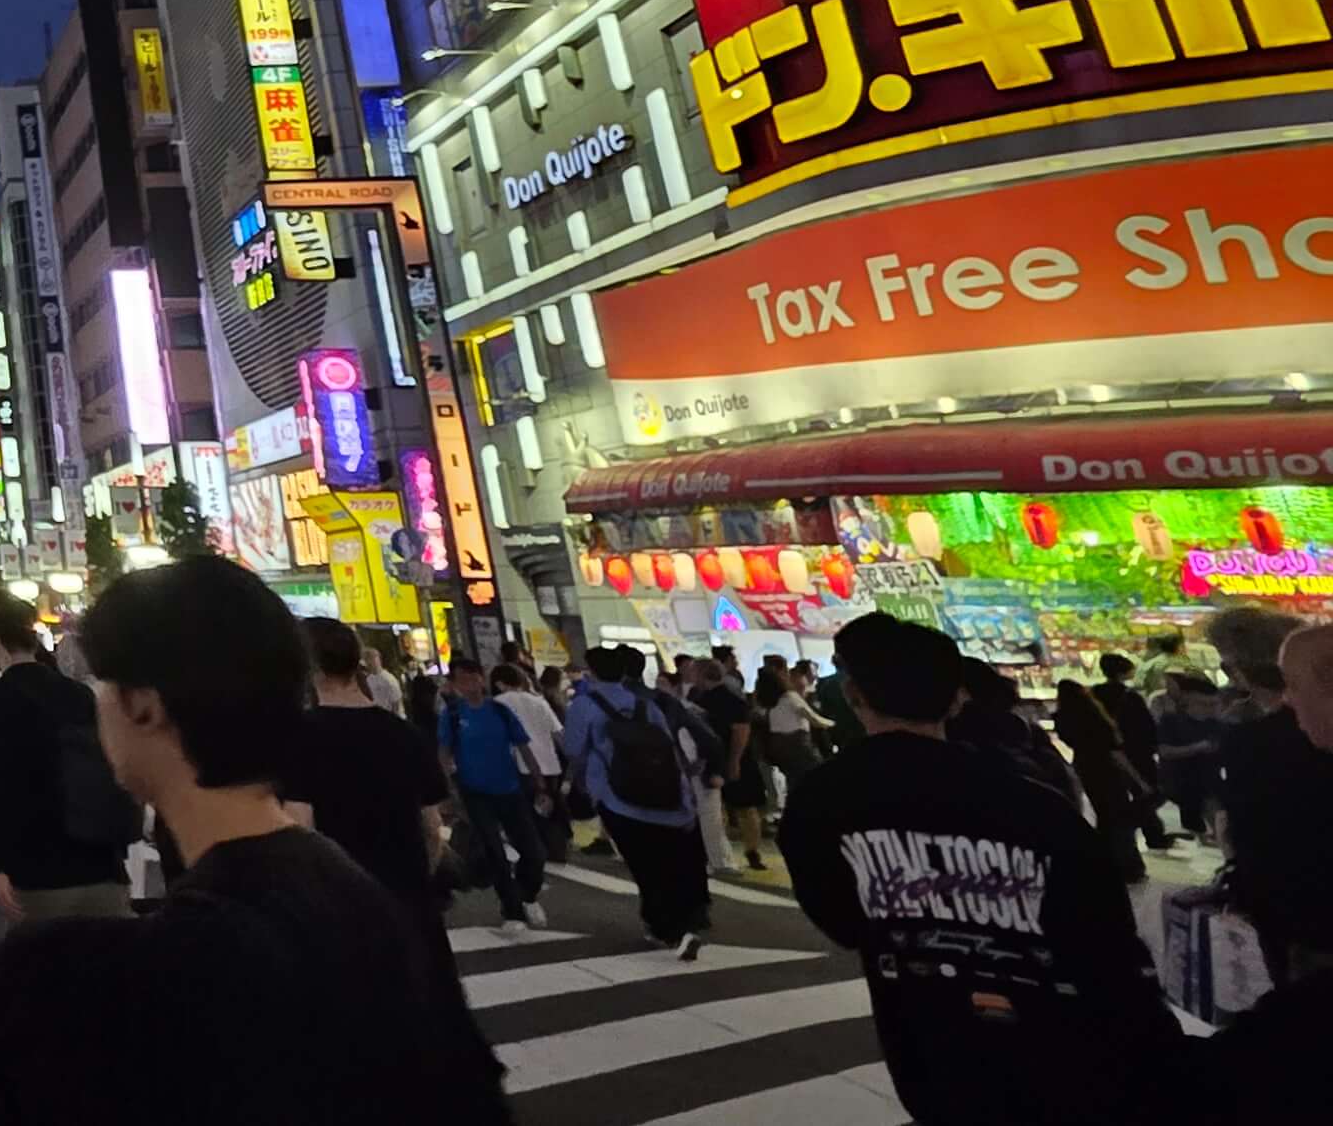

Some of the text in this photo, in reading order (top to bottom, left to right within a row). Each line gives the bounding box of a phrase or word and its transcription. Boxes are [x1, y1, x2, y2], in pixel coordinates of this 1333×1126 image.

[262, 67, 293, 82] 4F
[265, 88, 305, 144] 麻雀
[504, 123, 630, 210] Don Quijote
[271, 186, 394, 200] CENTRAL ROAD
[748, 278, 853, 346] Tax
[869, 245, 1081, 323] Free
[664, 393, 750, 424] Don Quijote
[1042, 453, 1144, 483] Don
[639, 470, 732, 500] Don Quijote
